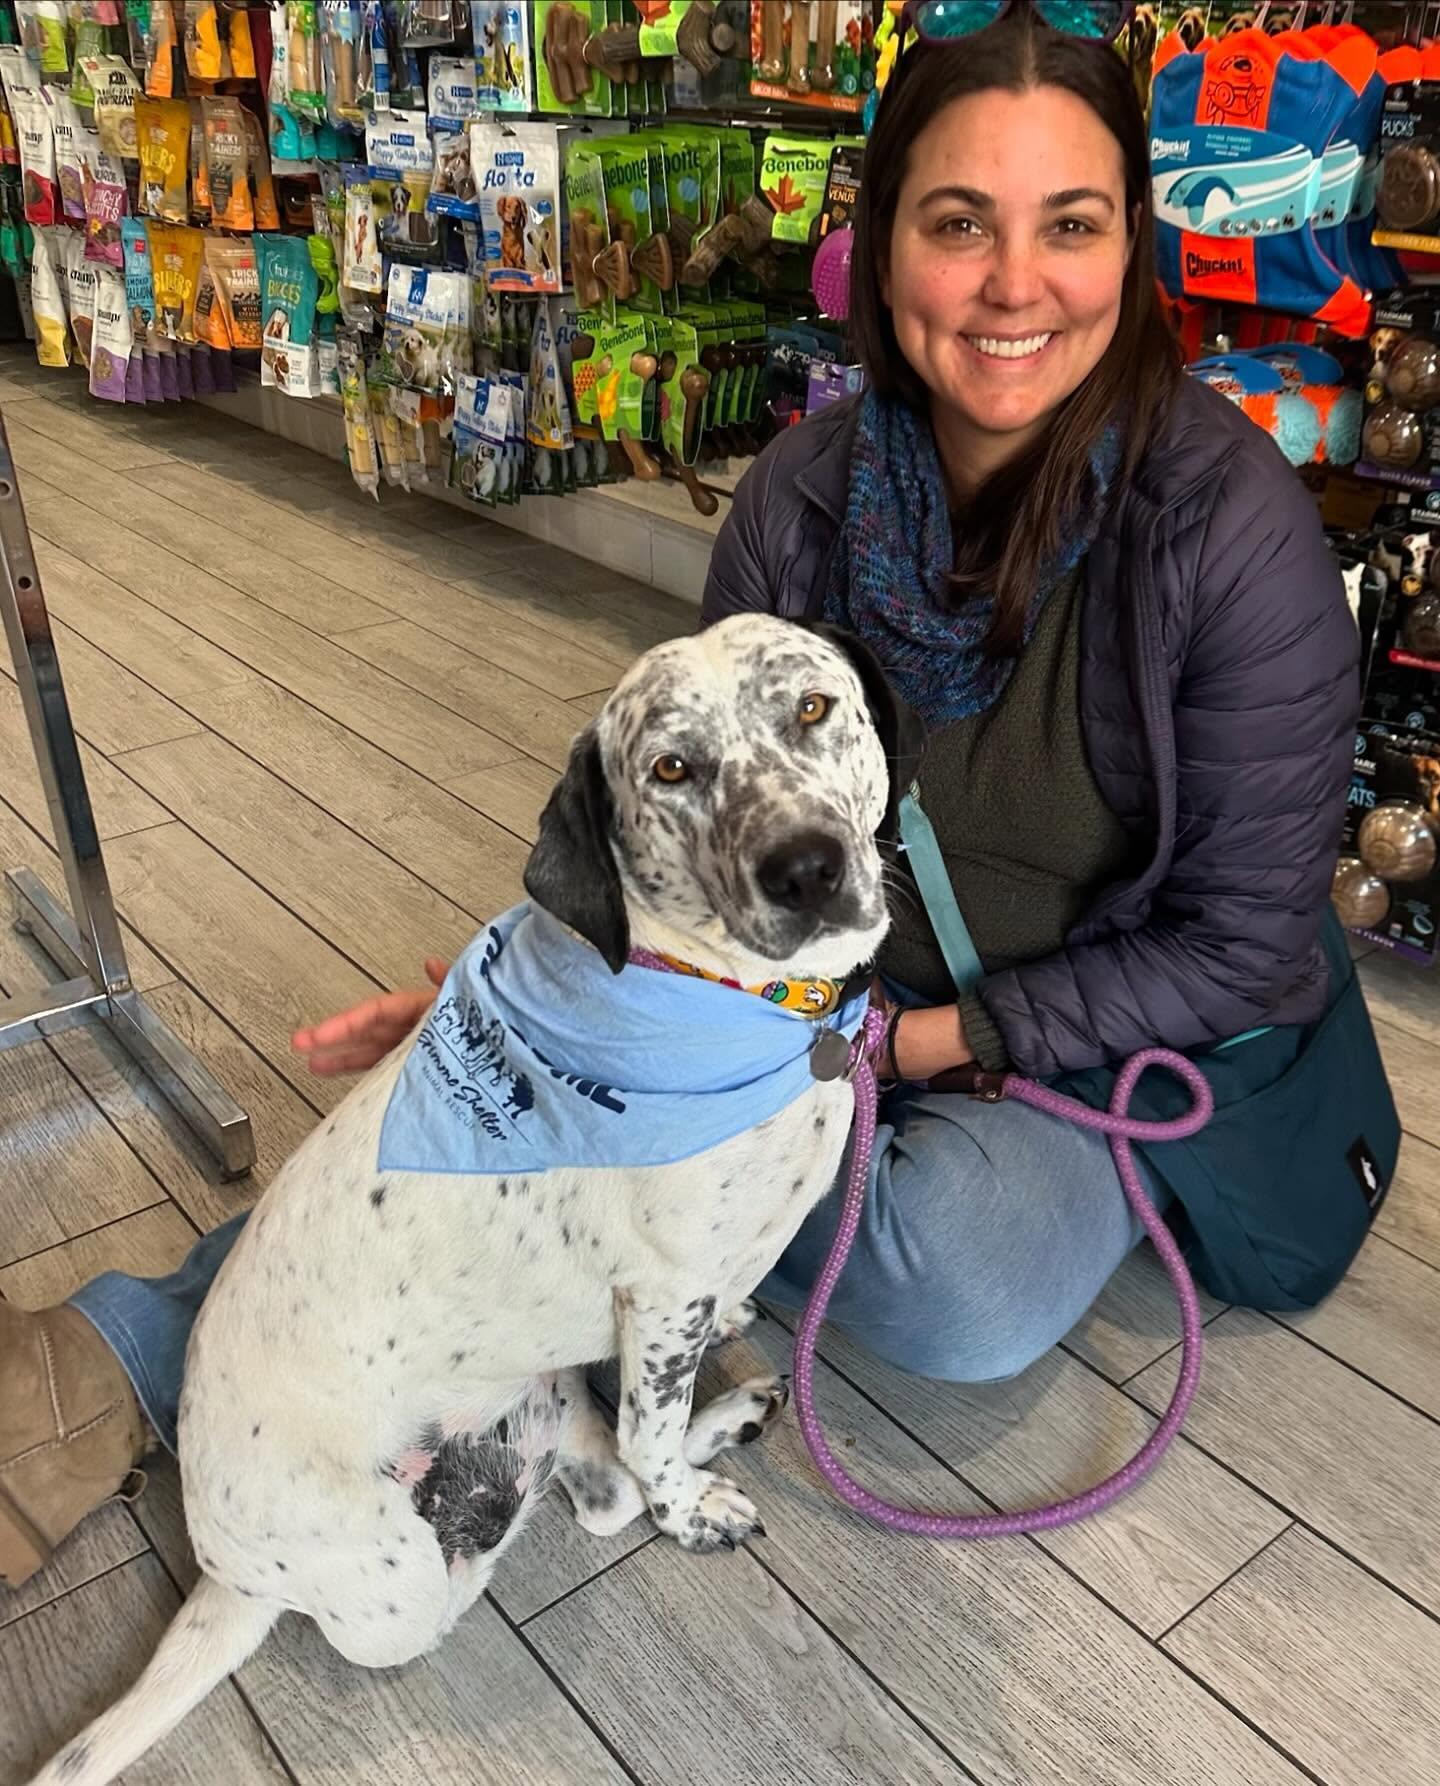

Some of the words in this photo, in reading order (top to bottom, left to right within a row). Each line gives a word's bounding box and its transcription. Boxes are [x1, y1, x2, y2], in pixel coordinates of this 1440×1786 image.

[1151, 137, 1191, 160] Chuckit!
[828, 188, 856, 204] VENUS
[1186, 252, 1243, 277] Chuckit!
[577, 317, 602, 332] Ben
[453, 1085, 508, 1142] Shelter
